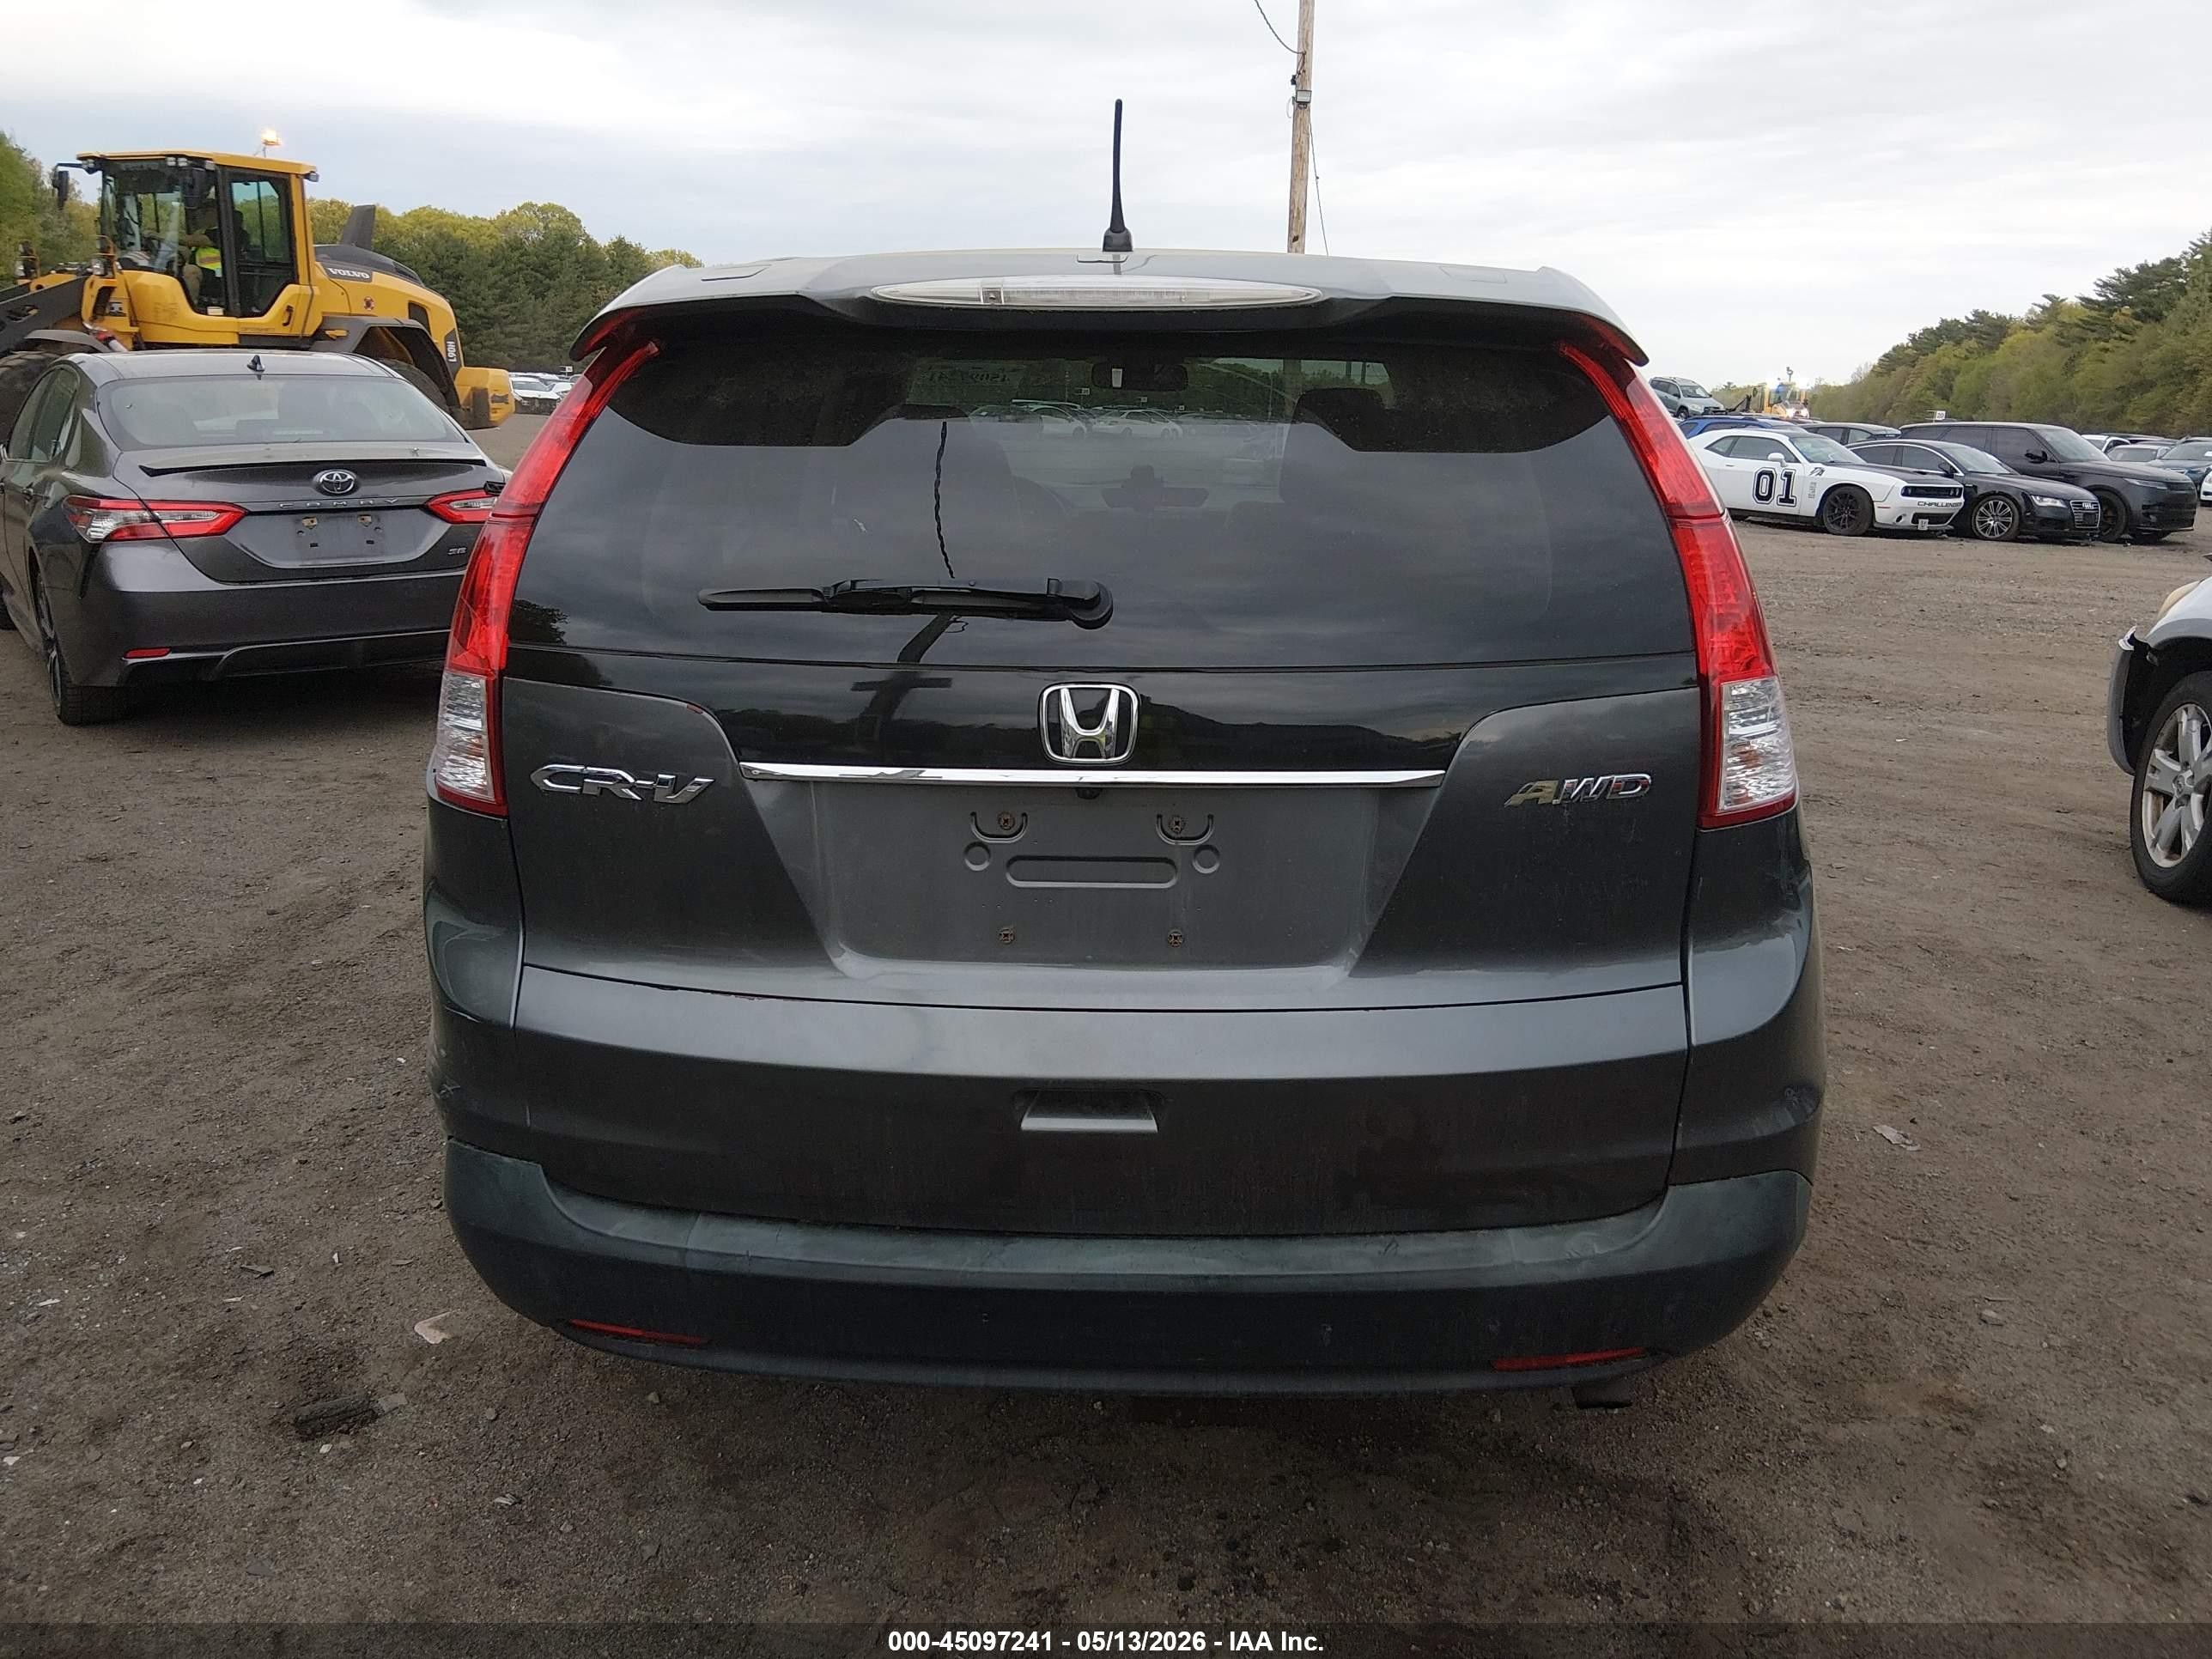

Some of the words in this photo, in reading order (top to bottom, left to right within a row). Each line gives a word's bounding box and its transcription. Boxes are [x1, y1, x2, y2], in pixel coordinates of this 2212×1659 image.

[327, 267, 370, 279] VOLVO
[446, 341, 458, 362] L90H
[1752, 466, 1797, 507] 01
[530, 763, 715, 804] CR-V
[1504, 774, 1651, 808] AWD
